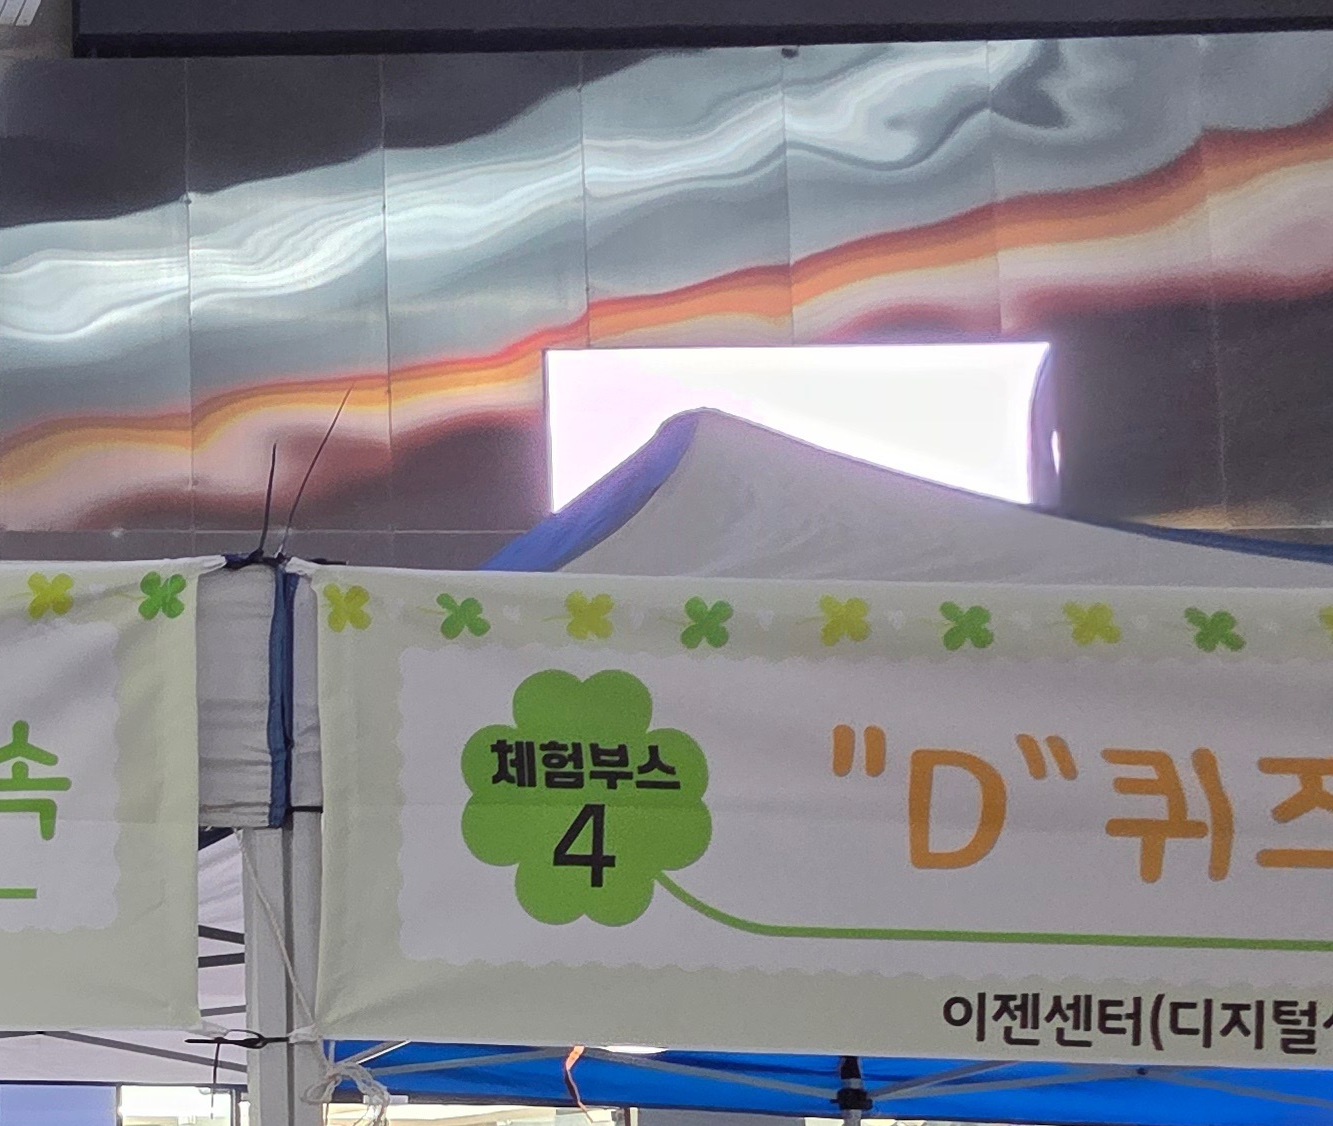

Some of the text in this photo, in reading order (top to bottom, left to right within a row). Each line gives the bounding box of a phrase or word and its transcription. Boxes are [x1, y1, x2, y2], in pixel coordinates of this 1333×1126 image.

[489, 739, 681, 791] 체험부스
[552, 803, 616, 888] 4
[943, 990, 1333, 1056] 이젠센터(디지털
